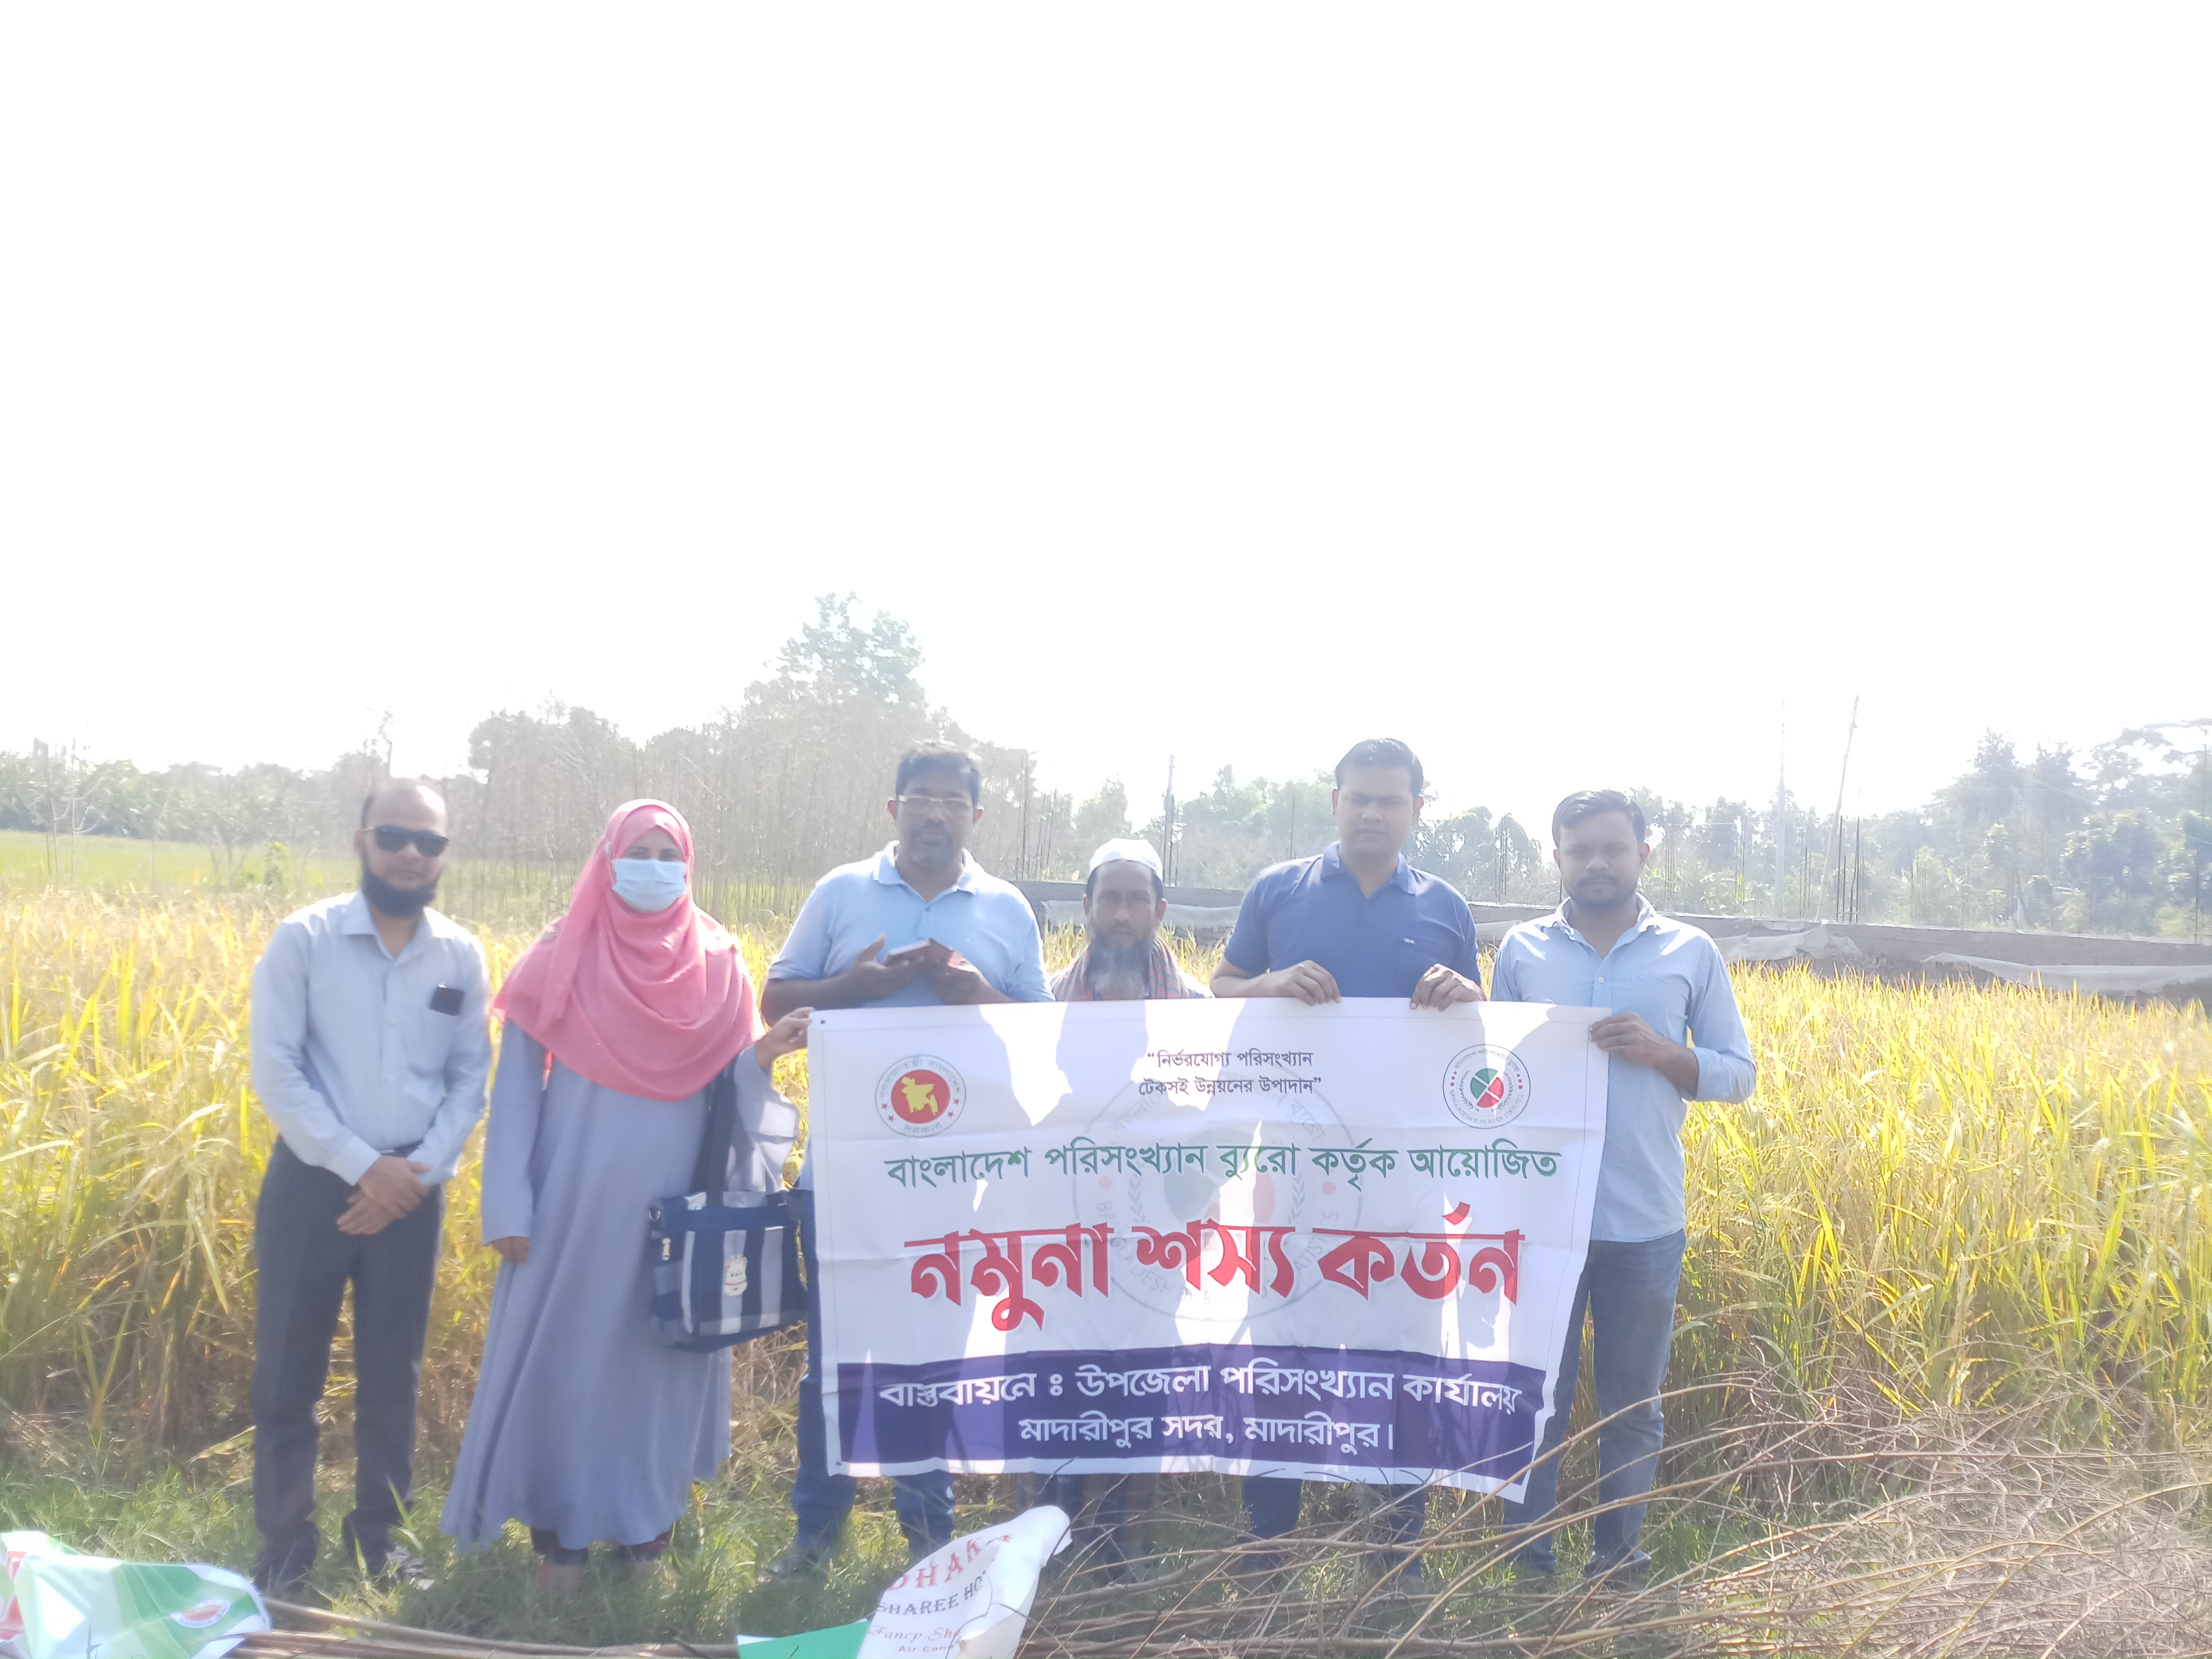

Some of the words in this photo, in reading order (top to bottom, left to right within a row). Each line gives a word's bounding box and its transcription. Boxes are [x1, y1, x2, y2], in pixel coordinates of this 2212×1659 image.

[1237, 1047, 1313, 1067] পরিসংখ্যান
[1139, 1077, 1190, 1095] টেকসই
[1193, 1076, 1254, 1096] উন্নয়নের
[1450, 1089, 1473, 1121] BANGLADESH
[1474, 1117, 1496, 1125] BUREAU
[1505, 1094, 1523, 1117] STATISTICS
[884, 1144, 1033, 1189] বাংলাদেশ
[1044, 1136, 1207, 1182] পরিসংখ্যান
[1216, 1142, 1301, 1181] ব্যুরো
[1309, 1138, 1399, 1192] কর্তৃক
[1407, 1138, 1561, 1179] আয়োজিত
[903, 1221, 1115, 1332] নমুনা
[1131, 1217, 1296, 1299] শস্য
[1312, 1201, 1526, 1306] কর্তন
[879, 1372, 1037, 1407] বাস্তবায়নে
[1075, 1364, 1212, 1397] উপজেলা
[1220, 1357, 1395, 1401] পরিসংখ্যান
[1402, 1373, 1523, 1415] কার্যালয়
[1019, 1409, 1154, 1449] মাদারীপুর
[1161, 1413, 1234, 1444] সদর,
[877, 1593, 959, 1615] SHAREE
[868, 1624, 923, 1643] Fancy
[899, 1645, 917, 1653] Air
